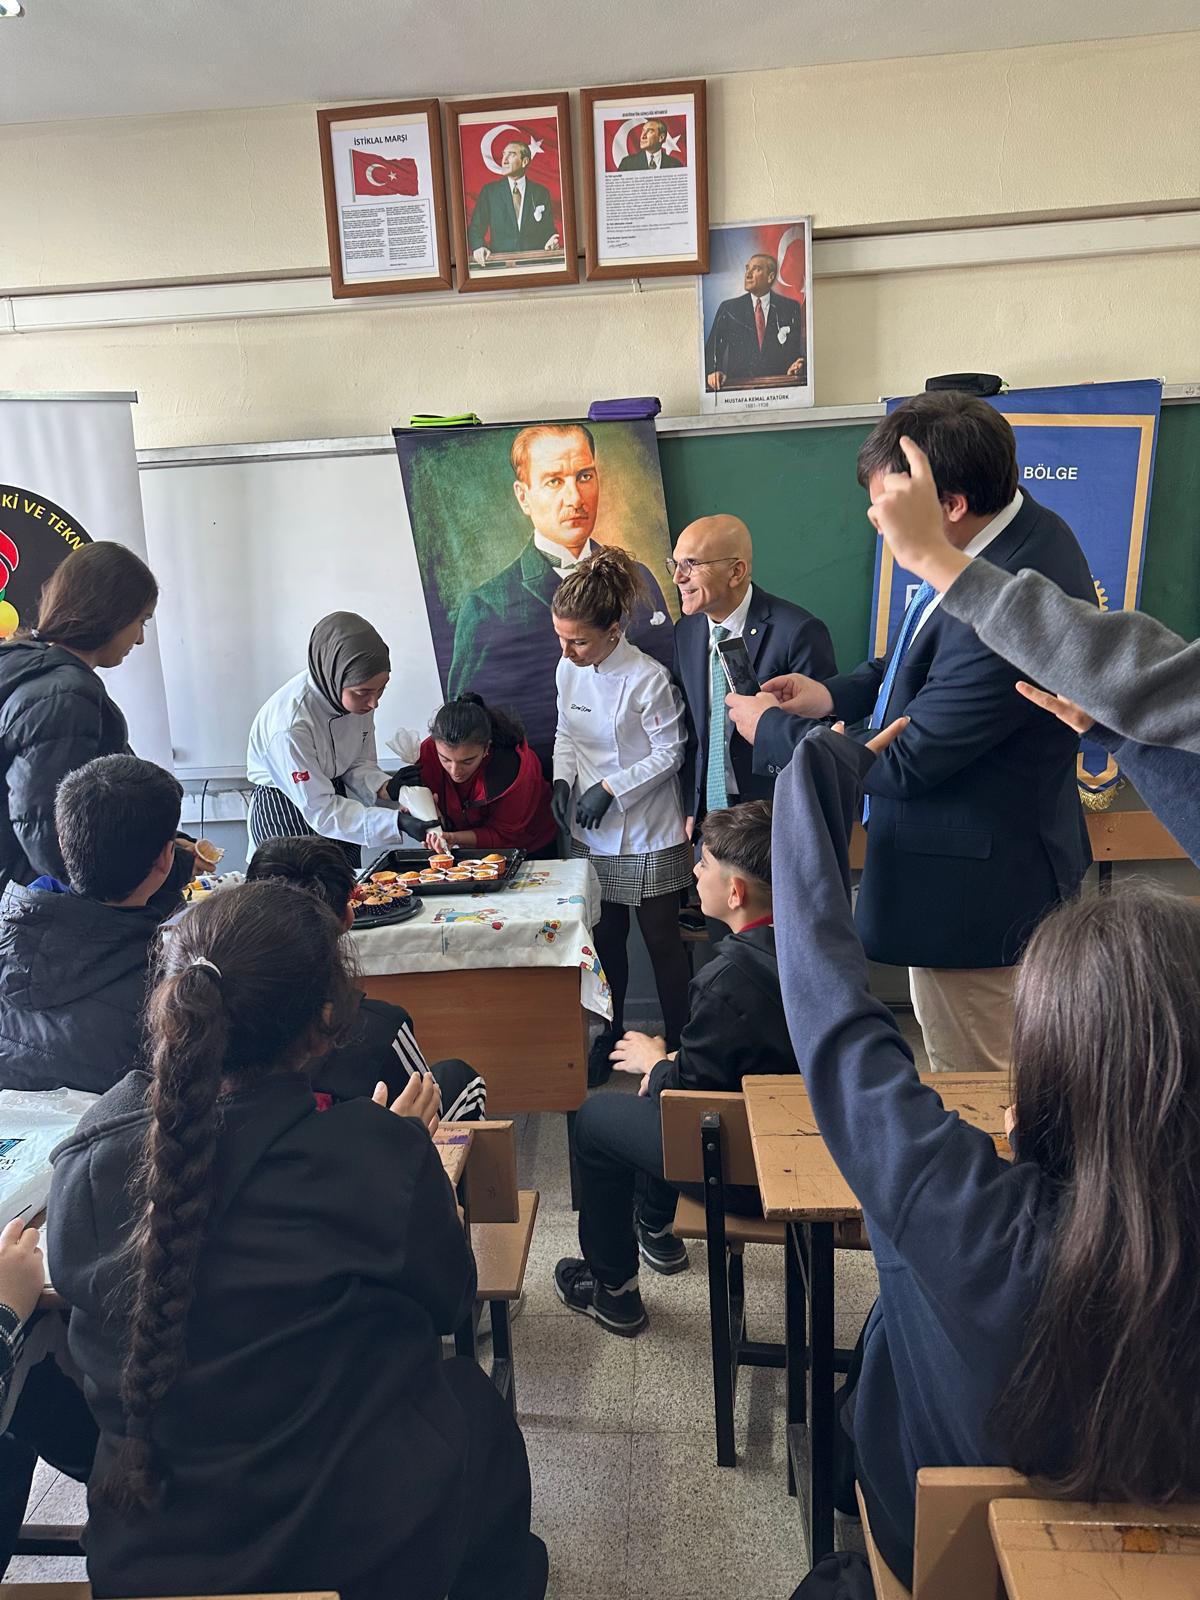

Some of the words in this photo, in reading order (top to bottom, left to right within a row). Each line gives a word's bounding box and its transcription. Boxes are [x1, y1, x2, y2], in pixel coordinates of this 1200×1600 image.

[353, 136, 383, 146] İSTİKLAL
[384, 134, 408, 143] MARŞI
[1023, 463, 1078, 480] BÖLGE
[24, 499, 46, 519] VE
